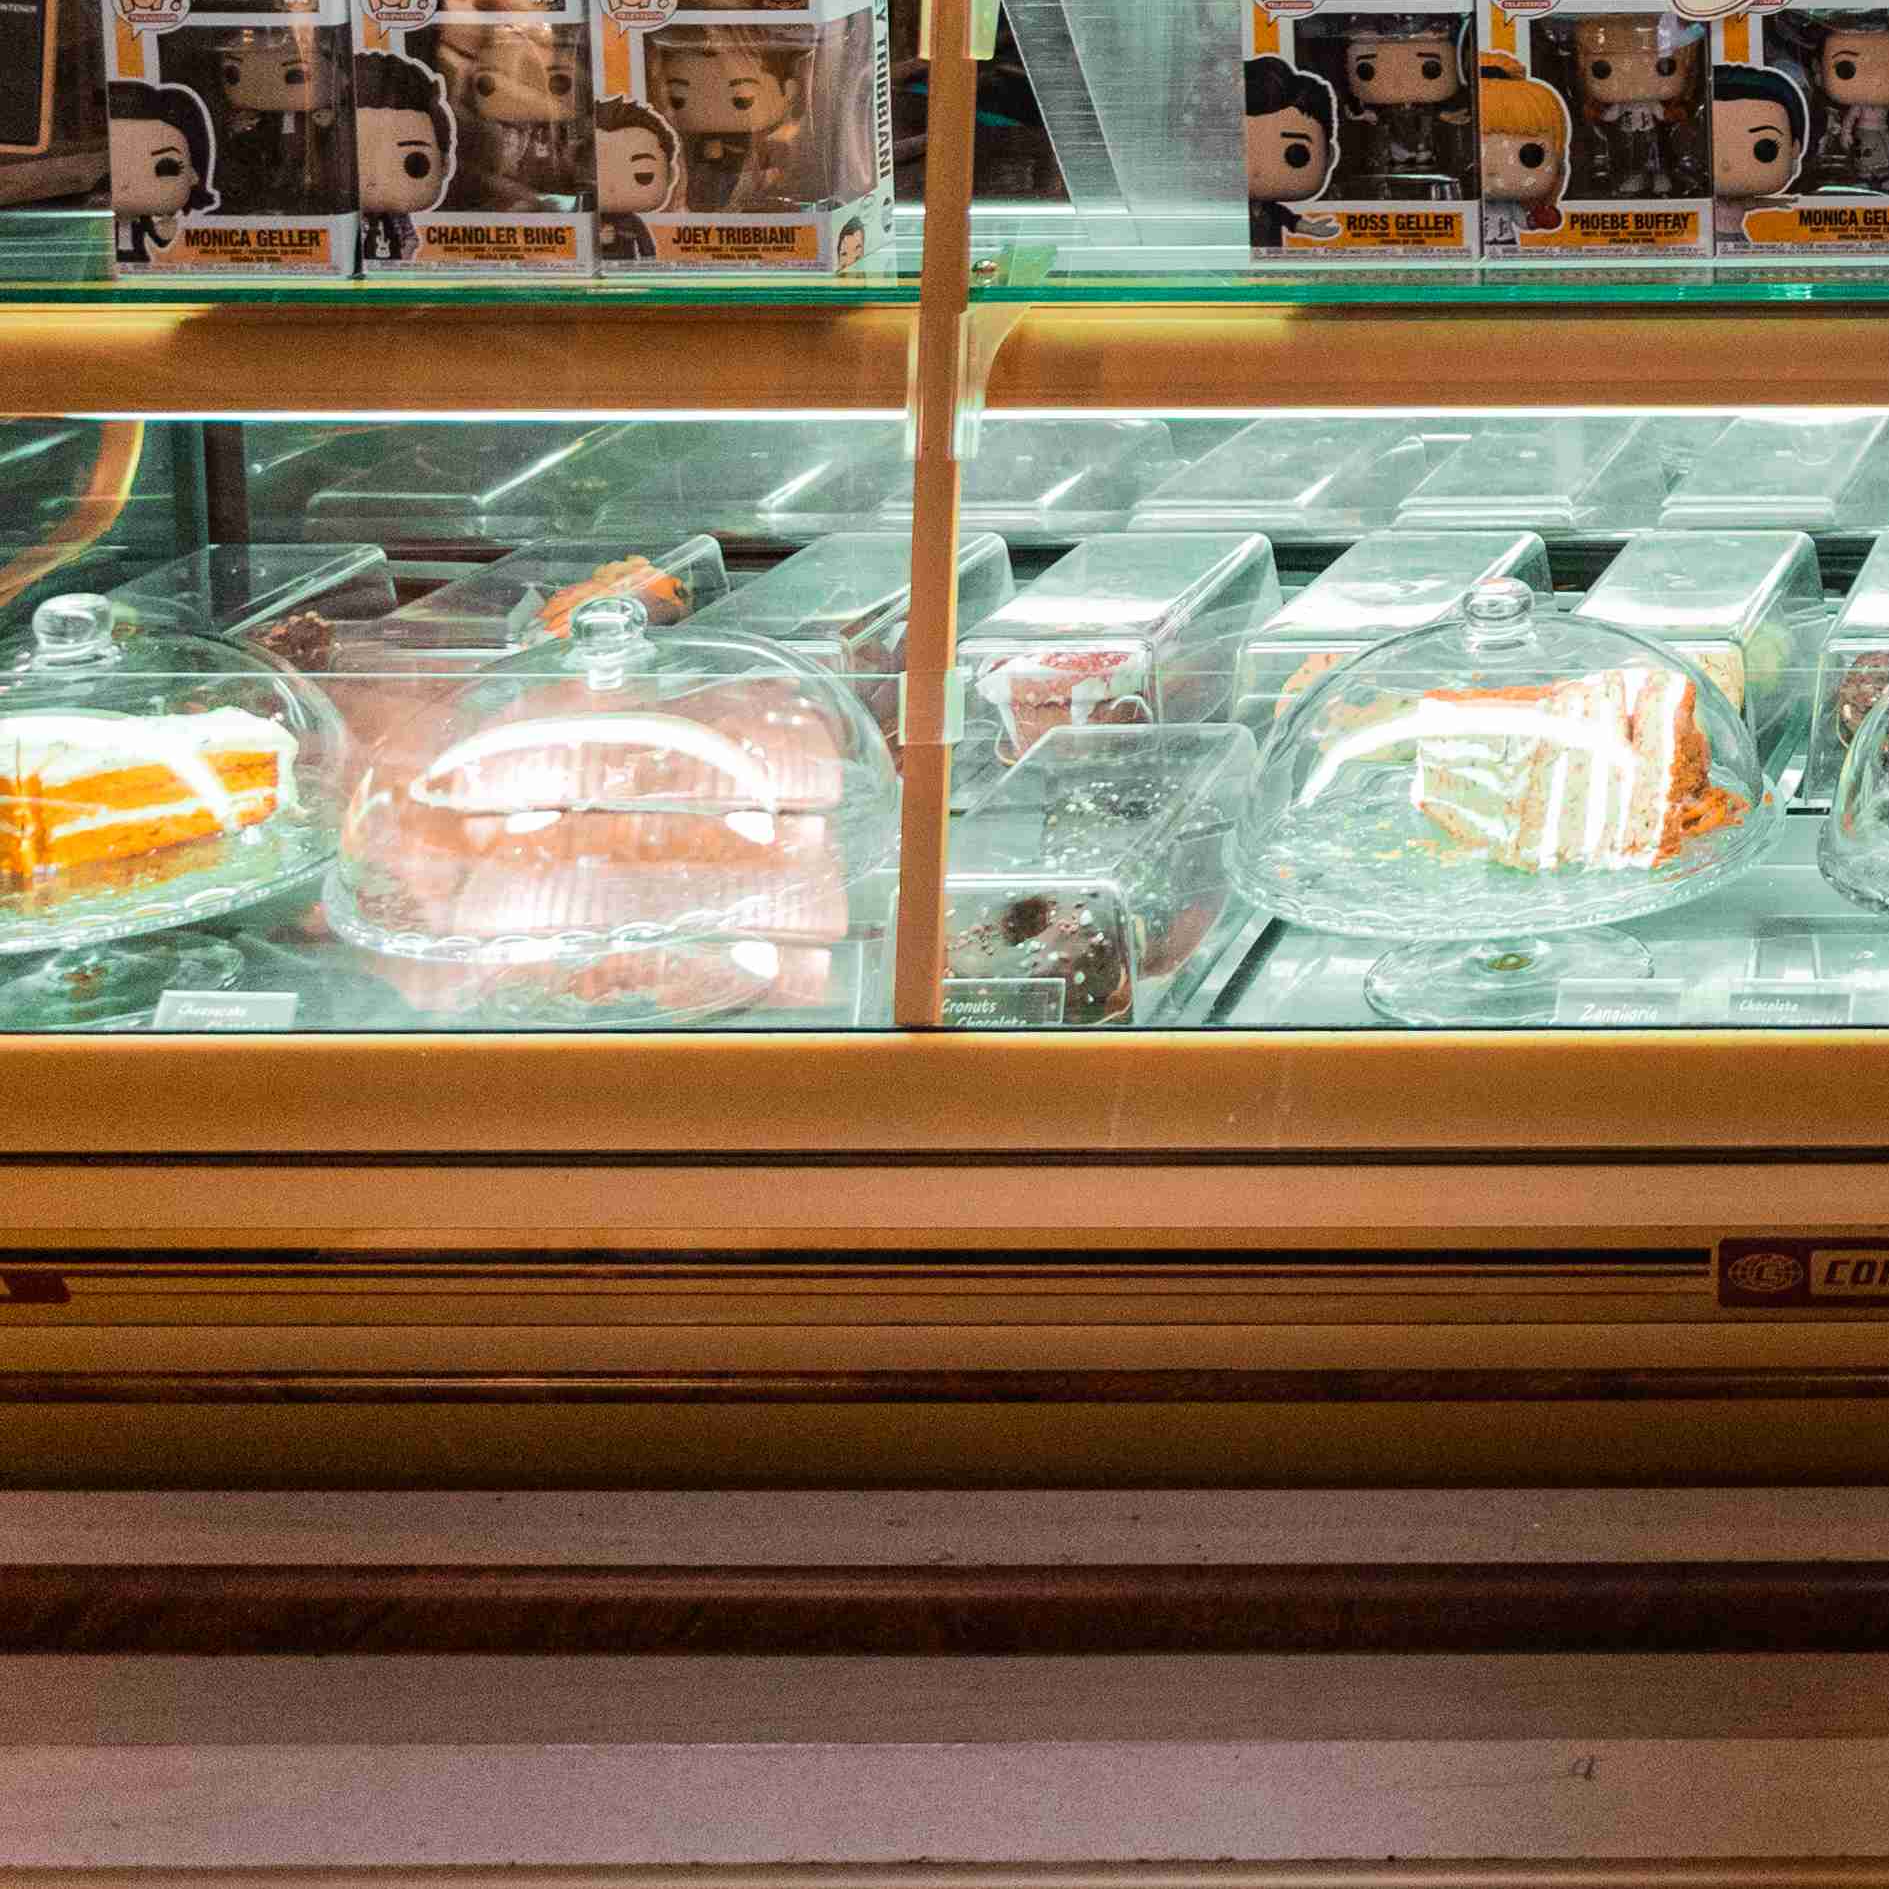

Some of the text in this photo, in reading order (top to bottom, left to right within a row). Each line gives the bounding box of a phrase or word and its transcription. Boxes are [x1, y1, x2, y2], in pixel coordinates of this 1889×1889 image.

[876, 38, 892, 179] TRIBBIANI
[1346, 213, 1455, 231] ROSS GELLER
[1569, 213, 1691, 231] PHOEBE BUFFAY
[1798, 209, 1859, 226] MONICA
[184, 228, 321, 247] MONICA GELLER
[425, 226, 567, 245] CHANDLER BING
[671, 225, 797, 245] JOEY TRIBBIANI
[940, 997, 999, 1015] Cronuts
